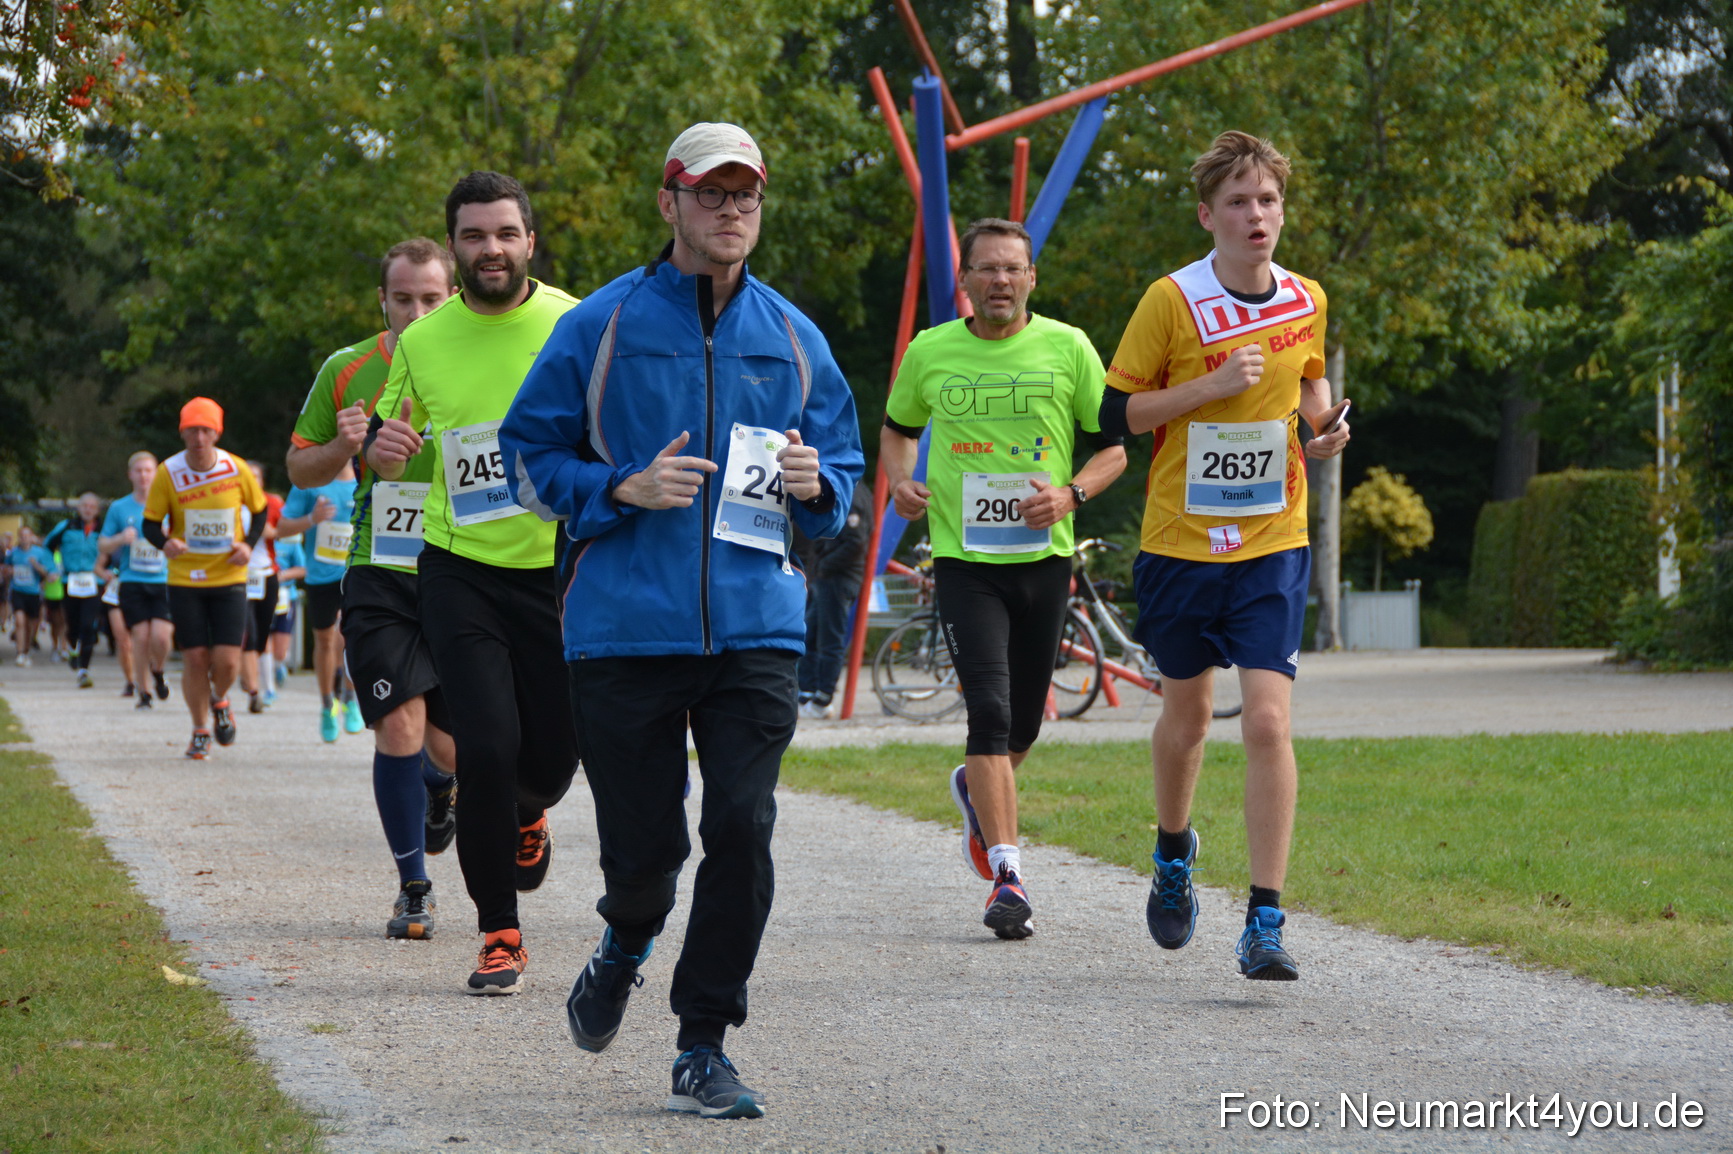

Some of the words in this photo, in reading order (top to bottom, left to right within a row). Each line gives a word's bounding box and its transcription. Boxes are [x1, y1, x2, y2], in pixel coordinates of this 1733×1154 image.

[1268, 324, 1314, 353] BÖGL
[939, 371, 1054, 417] OPF
[1227, 430, 1262, 441] BOCK
[951, 441, 995, 454] MERZ
[456, 450, 507, 488] 245
[1202, 449, 1274, 481] 2637
[742, 464, 790, 511] 24
[995, 479, 1026, 488] BOCK
[178, 489, 208, 504] MAX
[486, 489, 509, 504] Fabi
[729, 489, 734, 497] D
[1221, 489, 1254, 501] Yannik
[975, 498, 1023, 523] 290
[192, 523, 228, 537] 2639
[754, 513, 786, 533] Chris
